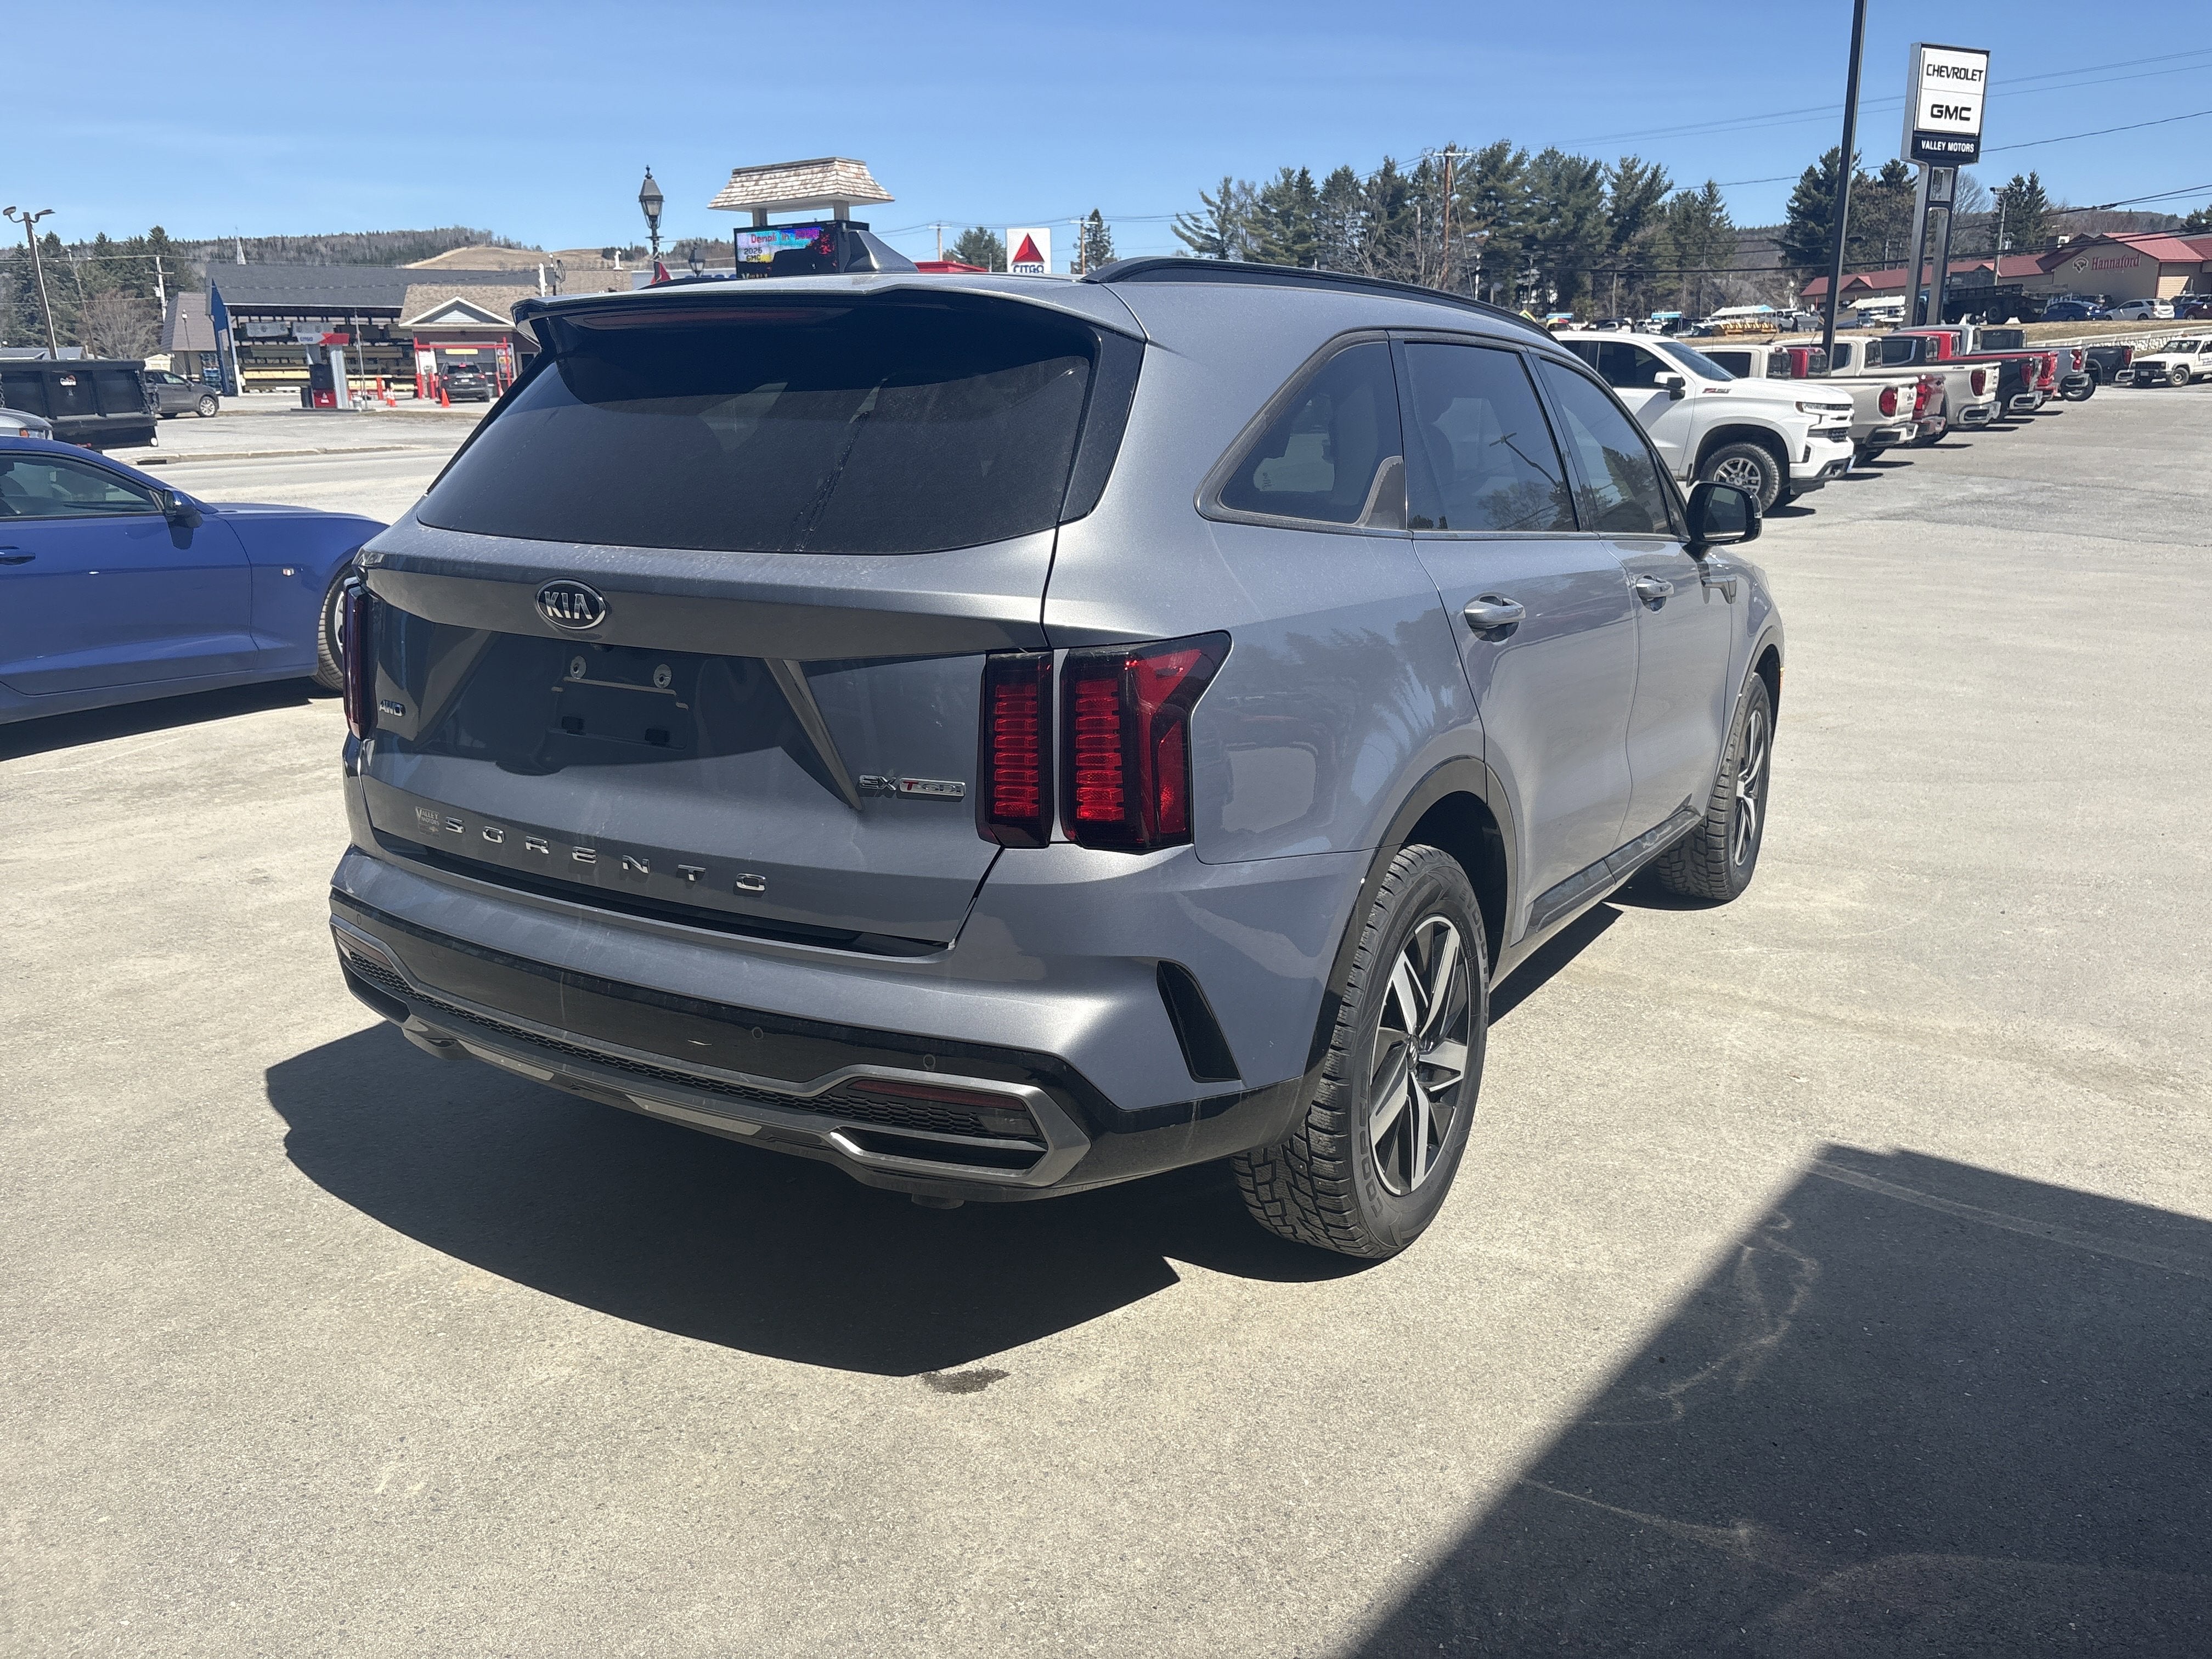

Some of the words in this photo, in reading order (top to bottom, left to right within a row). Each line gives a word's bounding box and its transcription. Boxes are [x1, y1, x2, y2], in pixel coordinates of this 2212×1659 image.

[1926, 64, 1984, 82] CHEVROLET
[1930, 104, 1972, 121] GMC
[1921, 139, 1946, 151] VALLEY
[1947, 141, 1975, 153] MOTORS
[1013, 264, 1045, 274] CITGO
[2091, 253, 2141, 270] Hannaford
[544, 591, 593, 620] KIA
[379, 699, 406, 716] AWD
[859, 774, 896, 791] EX
[415, 807, 439, 821] VALLEY
[421, 816, 439, 826] MOTORS
[445, 816, 767, 891] SORENTO
